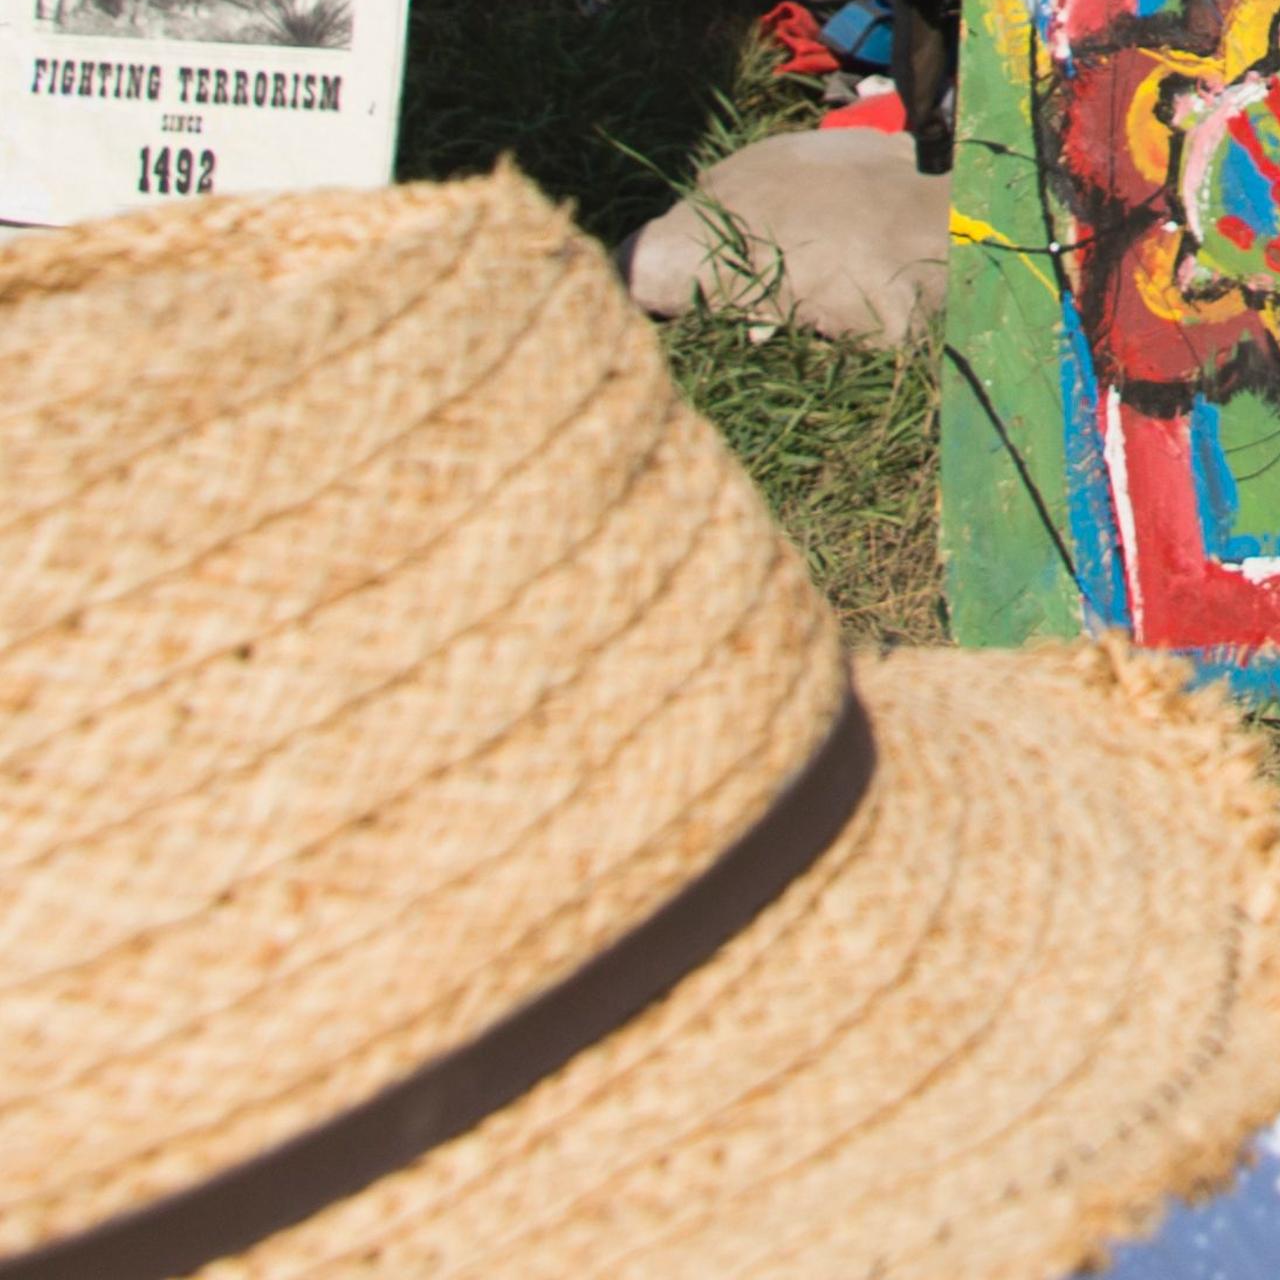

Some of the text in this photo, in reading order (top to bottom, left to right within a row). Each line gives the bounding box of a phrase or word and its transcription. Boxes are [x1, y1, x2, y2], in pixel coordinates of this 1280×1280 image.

[32, 58, 342, 112] FIGHTING TERRORISM
[161, 114, 203, 134] SINCE
[138, 146, 216, 195] 1492
